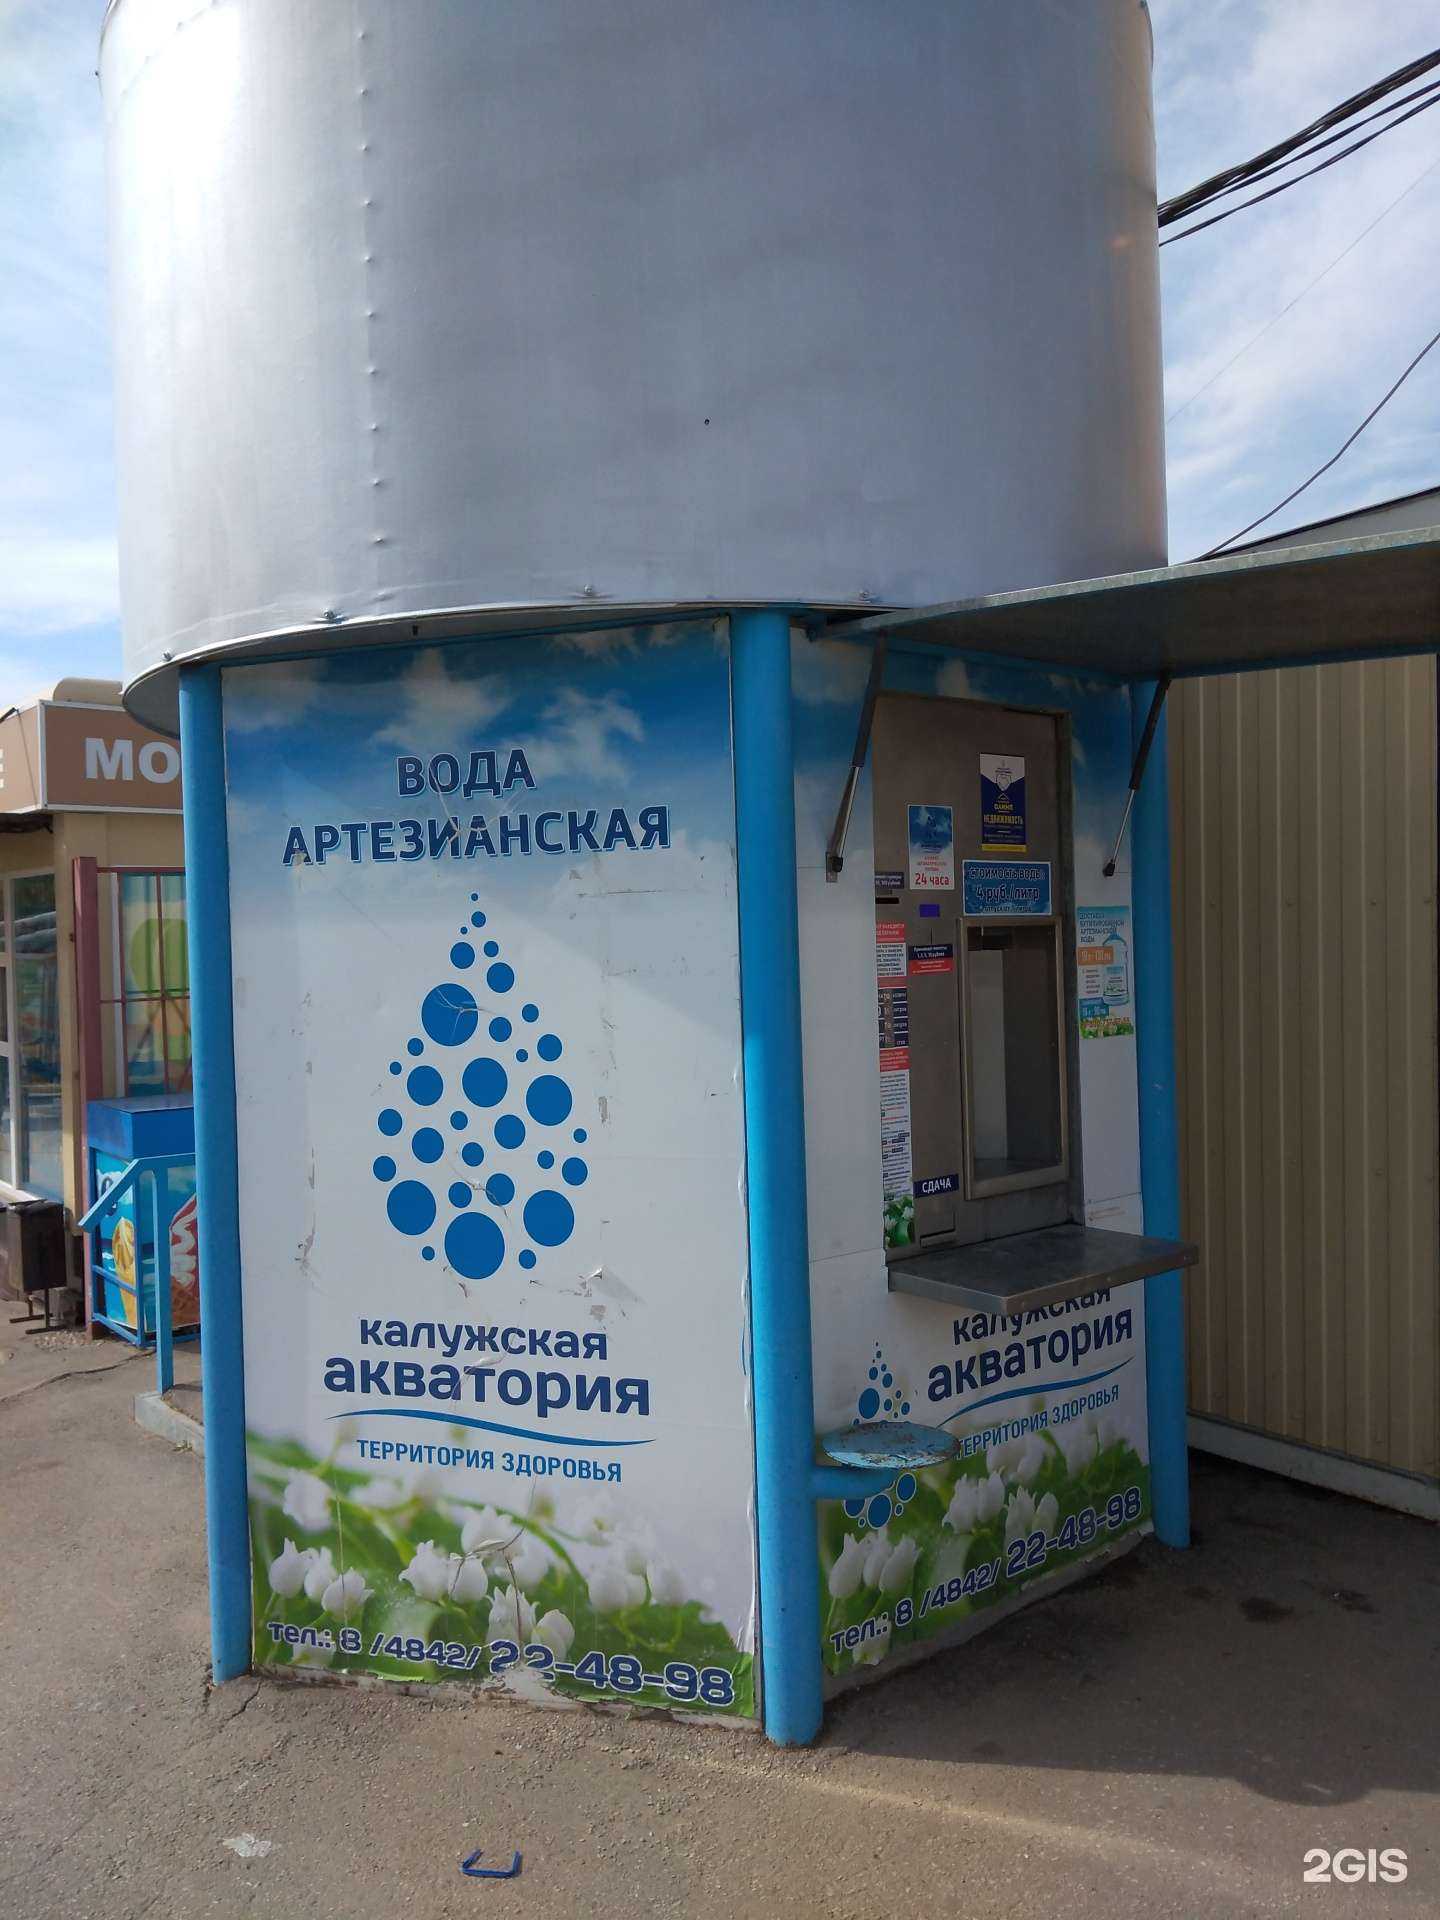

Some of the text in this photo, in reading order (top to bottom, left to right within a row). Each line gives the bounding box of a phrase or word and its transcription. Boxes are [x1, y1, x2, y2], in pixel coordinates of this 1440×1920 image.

[397, 749, 536, 798] ВОДА
[282, 805, 671, 866] АРТЕЗИАНСКАЯ
[914, 872, 928, 886] 24
[929, 875, 950, 887] часа
[976, 884, 984, 898] 4
[921, 1176, 952, 1195] СДАЧА
[360, 1319, 608, 1361] калужская
[928, 1308, 1133, 1403] акватория
[324, 1357, 650, 1418] акватория
[956, 1384, 1120, 1460] ТЕРРИТОРИЯ ЗДОРОВЬЯ
[357, 1440, 622, 1483] ТЕРРИТОРИЯ ЗДОРОВЬЯ
[830, 1486, 1142, 1654] тел.: 8 /4842/ 22-48-98
[267, 1621, 735, 1706] тел.: 8 /4842/ 22-48-98
